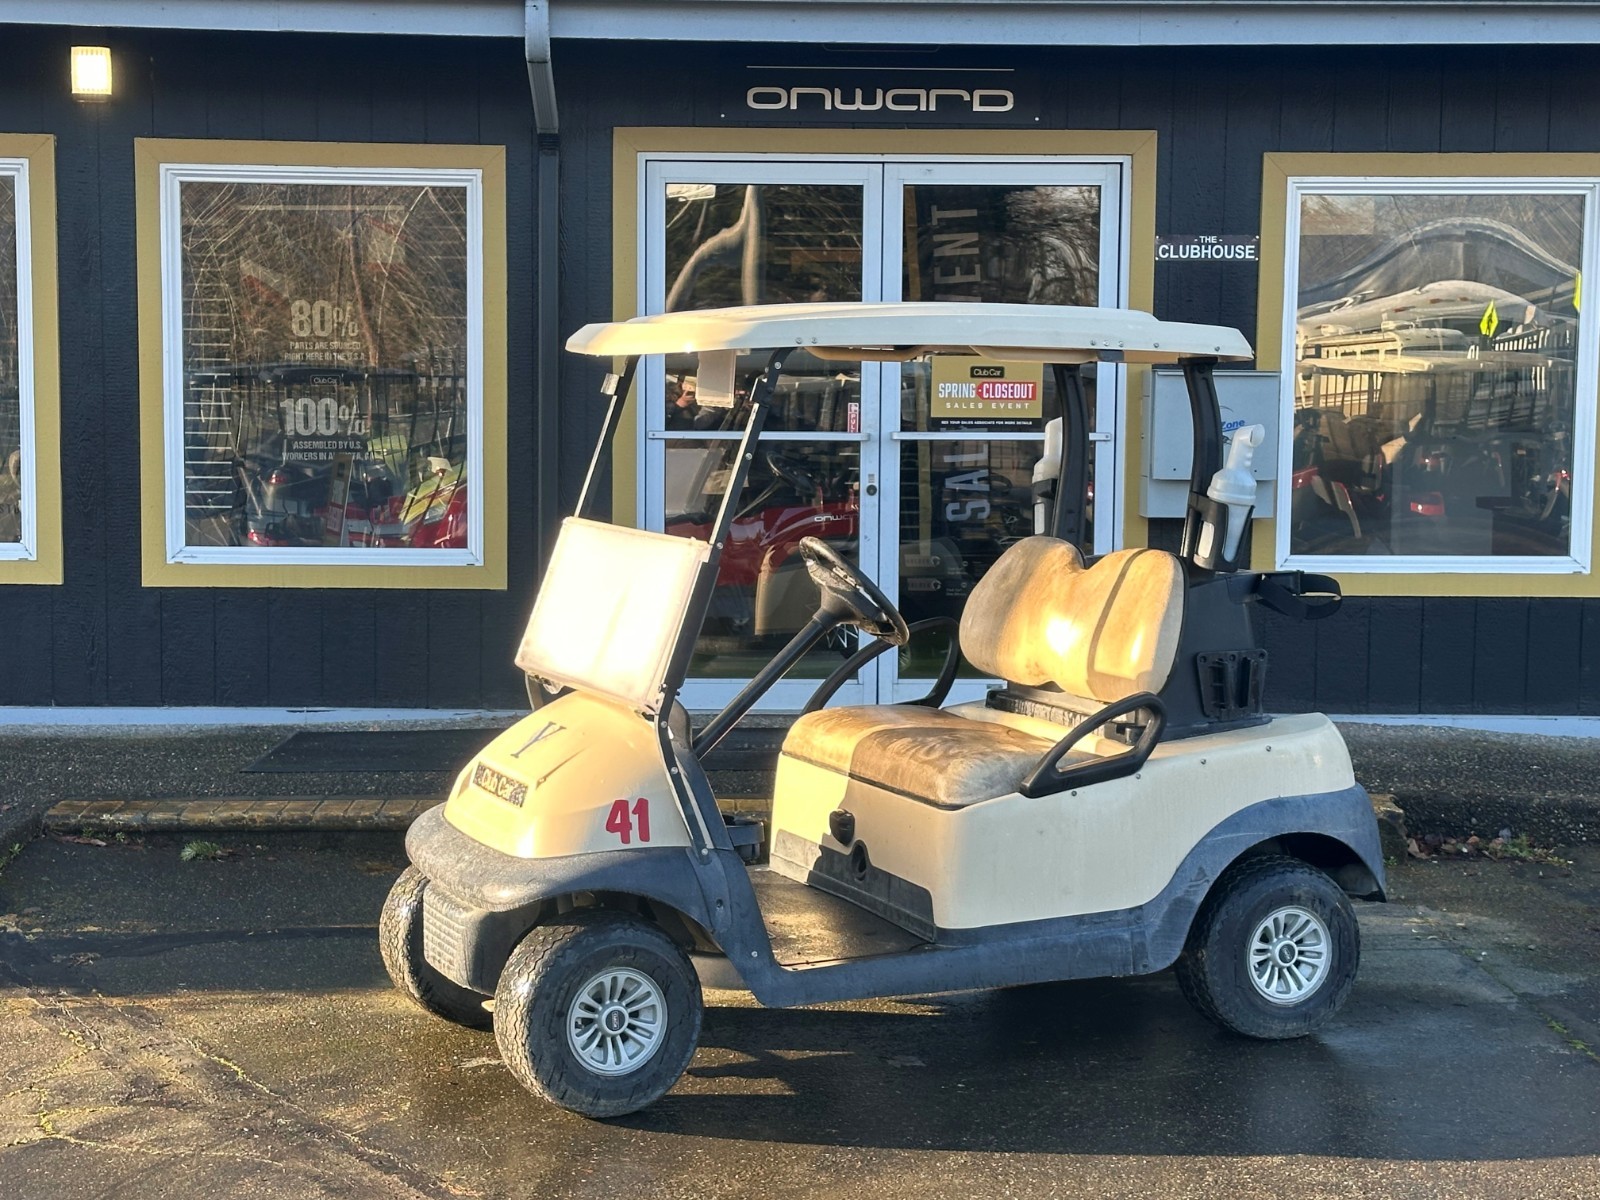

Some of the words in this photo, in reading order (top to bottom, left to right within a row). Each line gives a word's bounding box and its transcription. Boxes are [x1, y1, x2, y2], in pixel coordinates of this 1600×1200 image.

[747, 86, 1014, 112] onward
[1199, 235, 1218, 243] THE
[931, 204, 981, 303] ENT
[1158, 244, 1256, 259] CLUBHOUSE
[290, 299, 360, 337] 80%
[314, 341, 329, 350] ARE
[305, 352, 323, 360] HERE
[938, 382, 976, 399] SPRING
[983, 383, 1034, 399] CLOSEOUT
[279, 397, 365, 436] 100%
[292, 440, 337, 450] ASSEMBLED
[338, 440, 348, 450] BY
[282, 451, 318, 461] WORKERS
[319, 451, 327, 461] IN
[605, 797, 650, 844] 41
